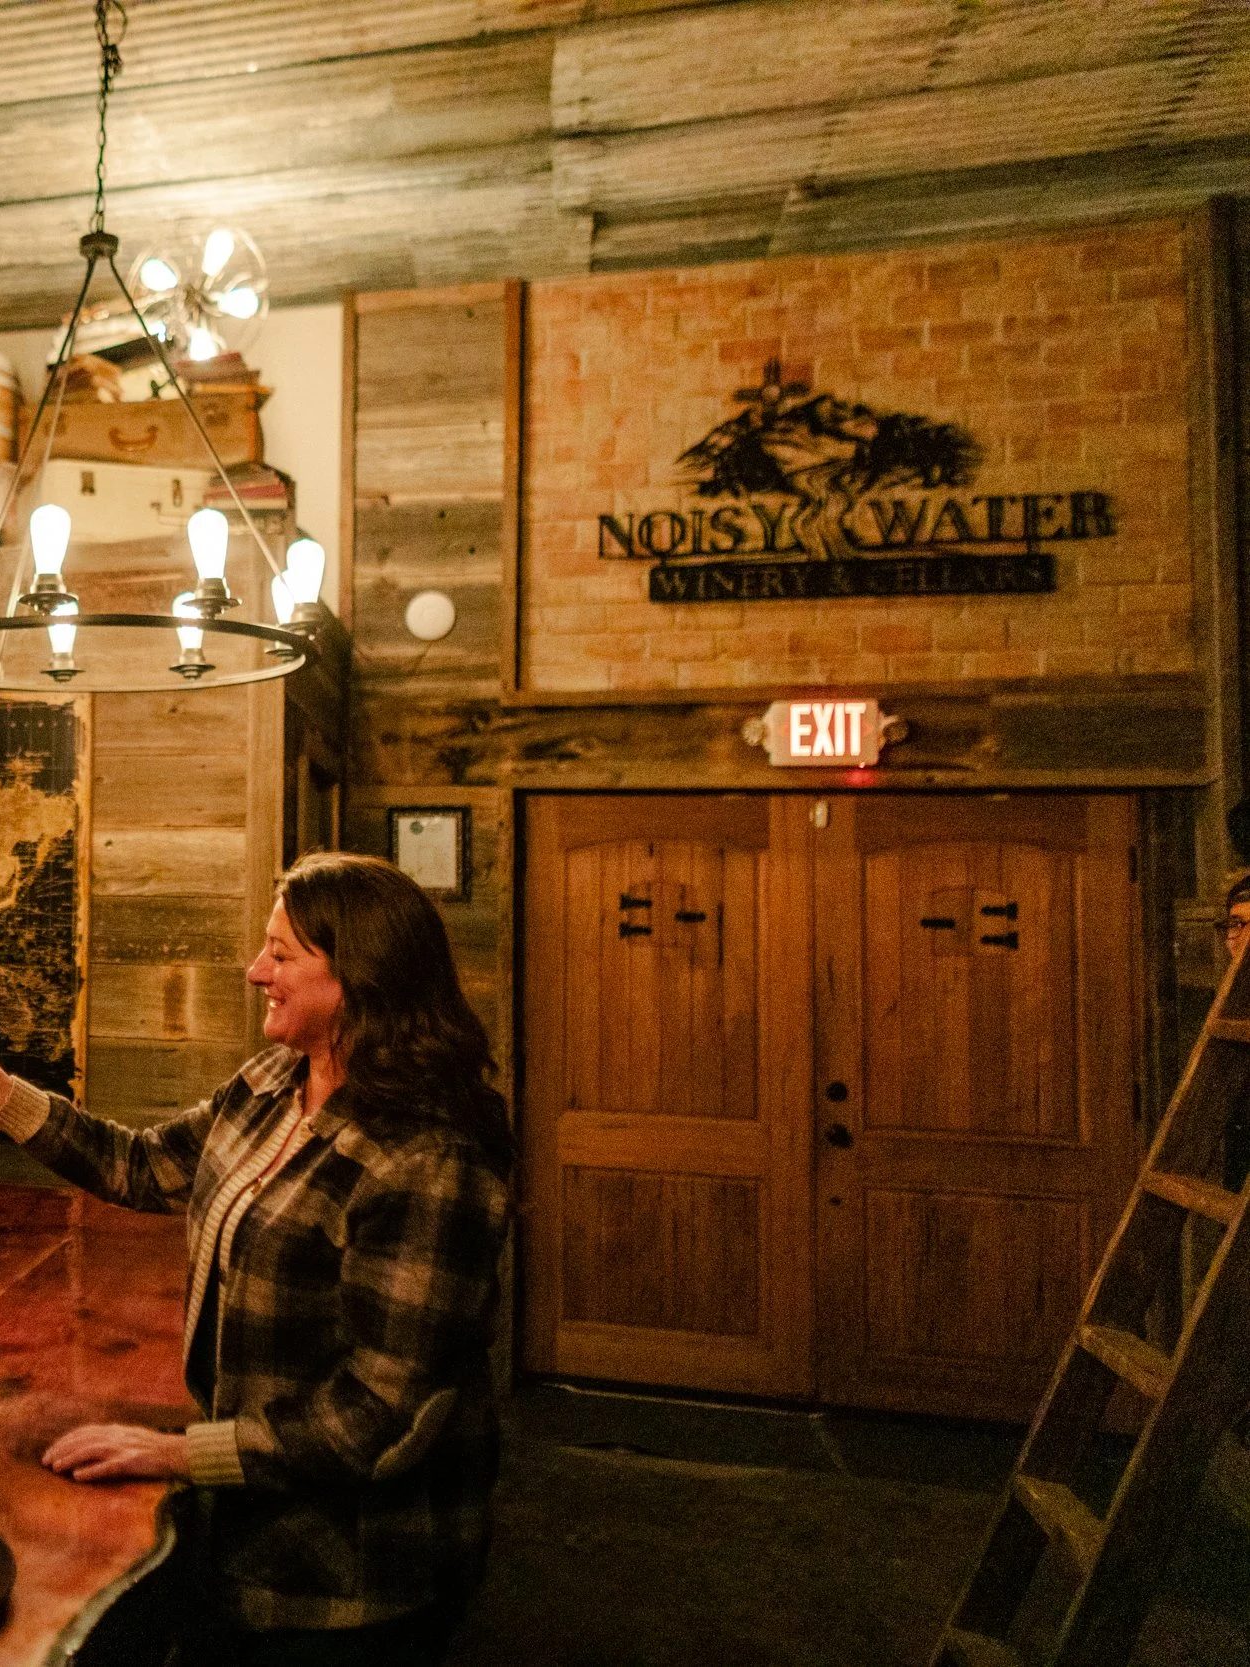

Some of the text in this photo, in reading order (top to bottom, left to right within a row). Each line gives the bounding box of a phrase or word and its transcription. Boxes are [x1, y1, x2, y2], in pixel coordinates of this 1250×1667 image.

[598, 490, 1118, 558] NOISY WATER
[656, 567, 811, 597] WINERY
[790, 702, 866, 757] EXIT
